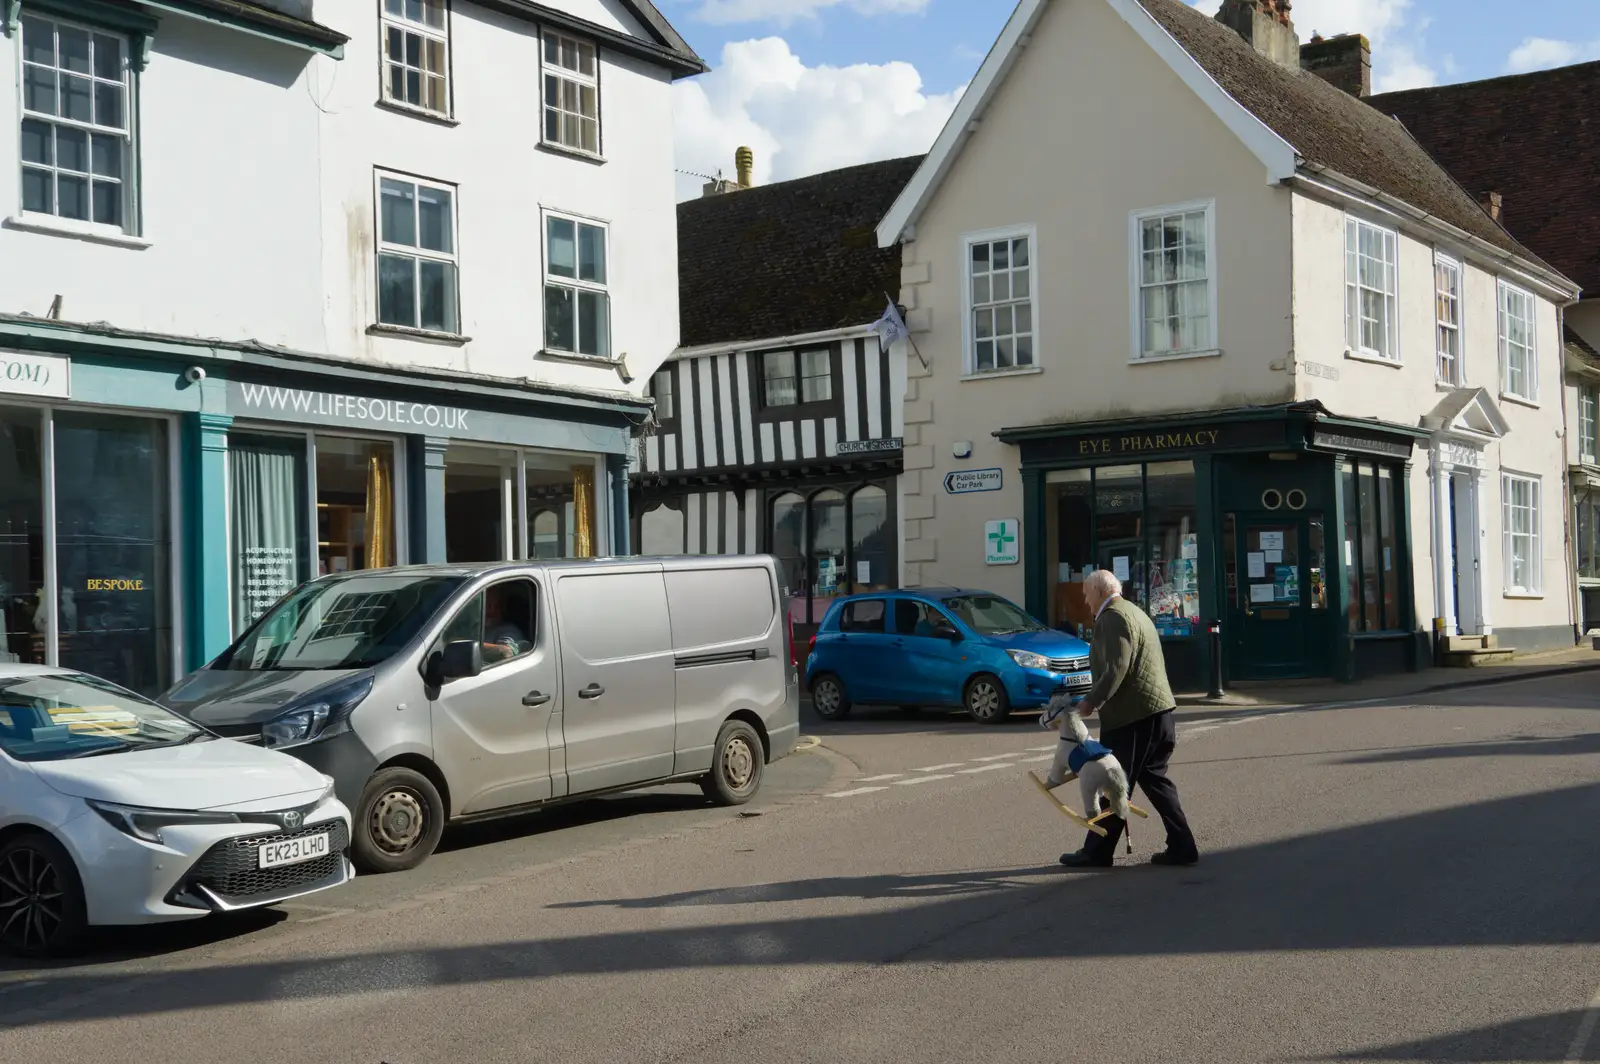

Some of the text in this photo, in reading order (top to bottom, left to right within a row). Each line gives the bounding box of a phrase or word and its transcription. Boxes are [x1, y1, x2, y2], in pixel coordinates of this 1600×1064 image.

[240, 382, 469, 430] WWW.LIFESOLE.CO.UK
[839, 442, 867, 452] CHURCH
[1079, 430, 1219, 453] EYE PHARMACY
[956, 472, 1000, 481] Public Library
[987, 554, 1017, 562] Pharmacy
[87, 579, 144, 591] BESPOKE
[266, 836, 325, 863] EK23 LHO
